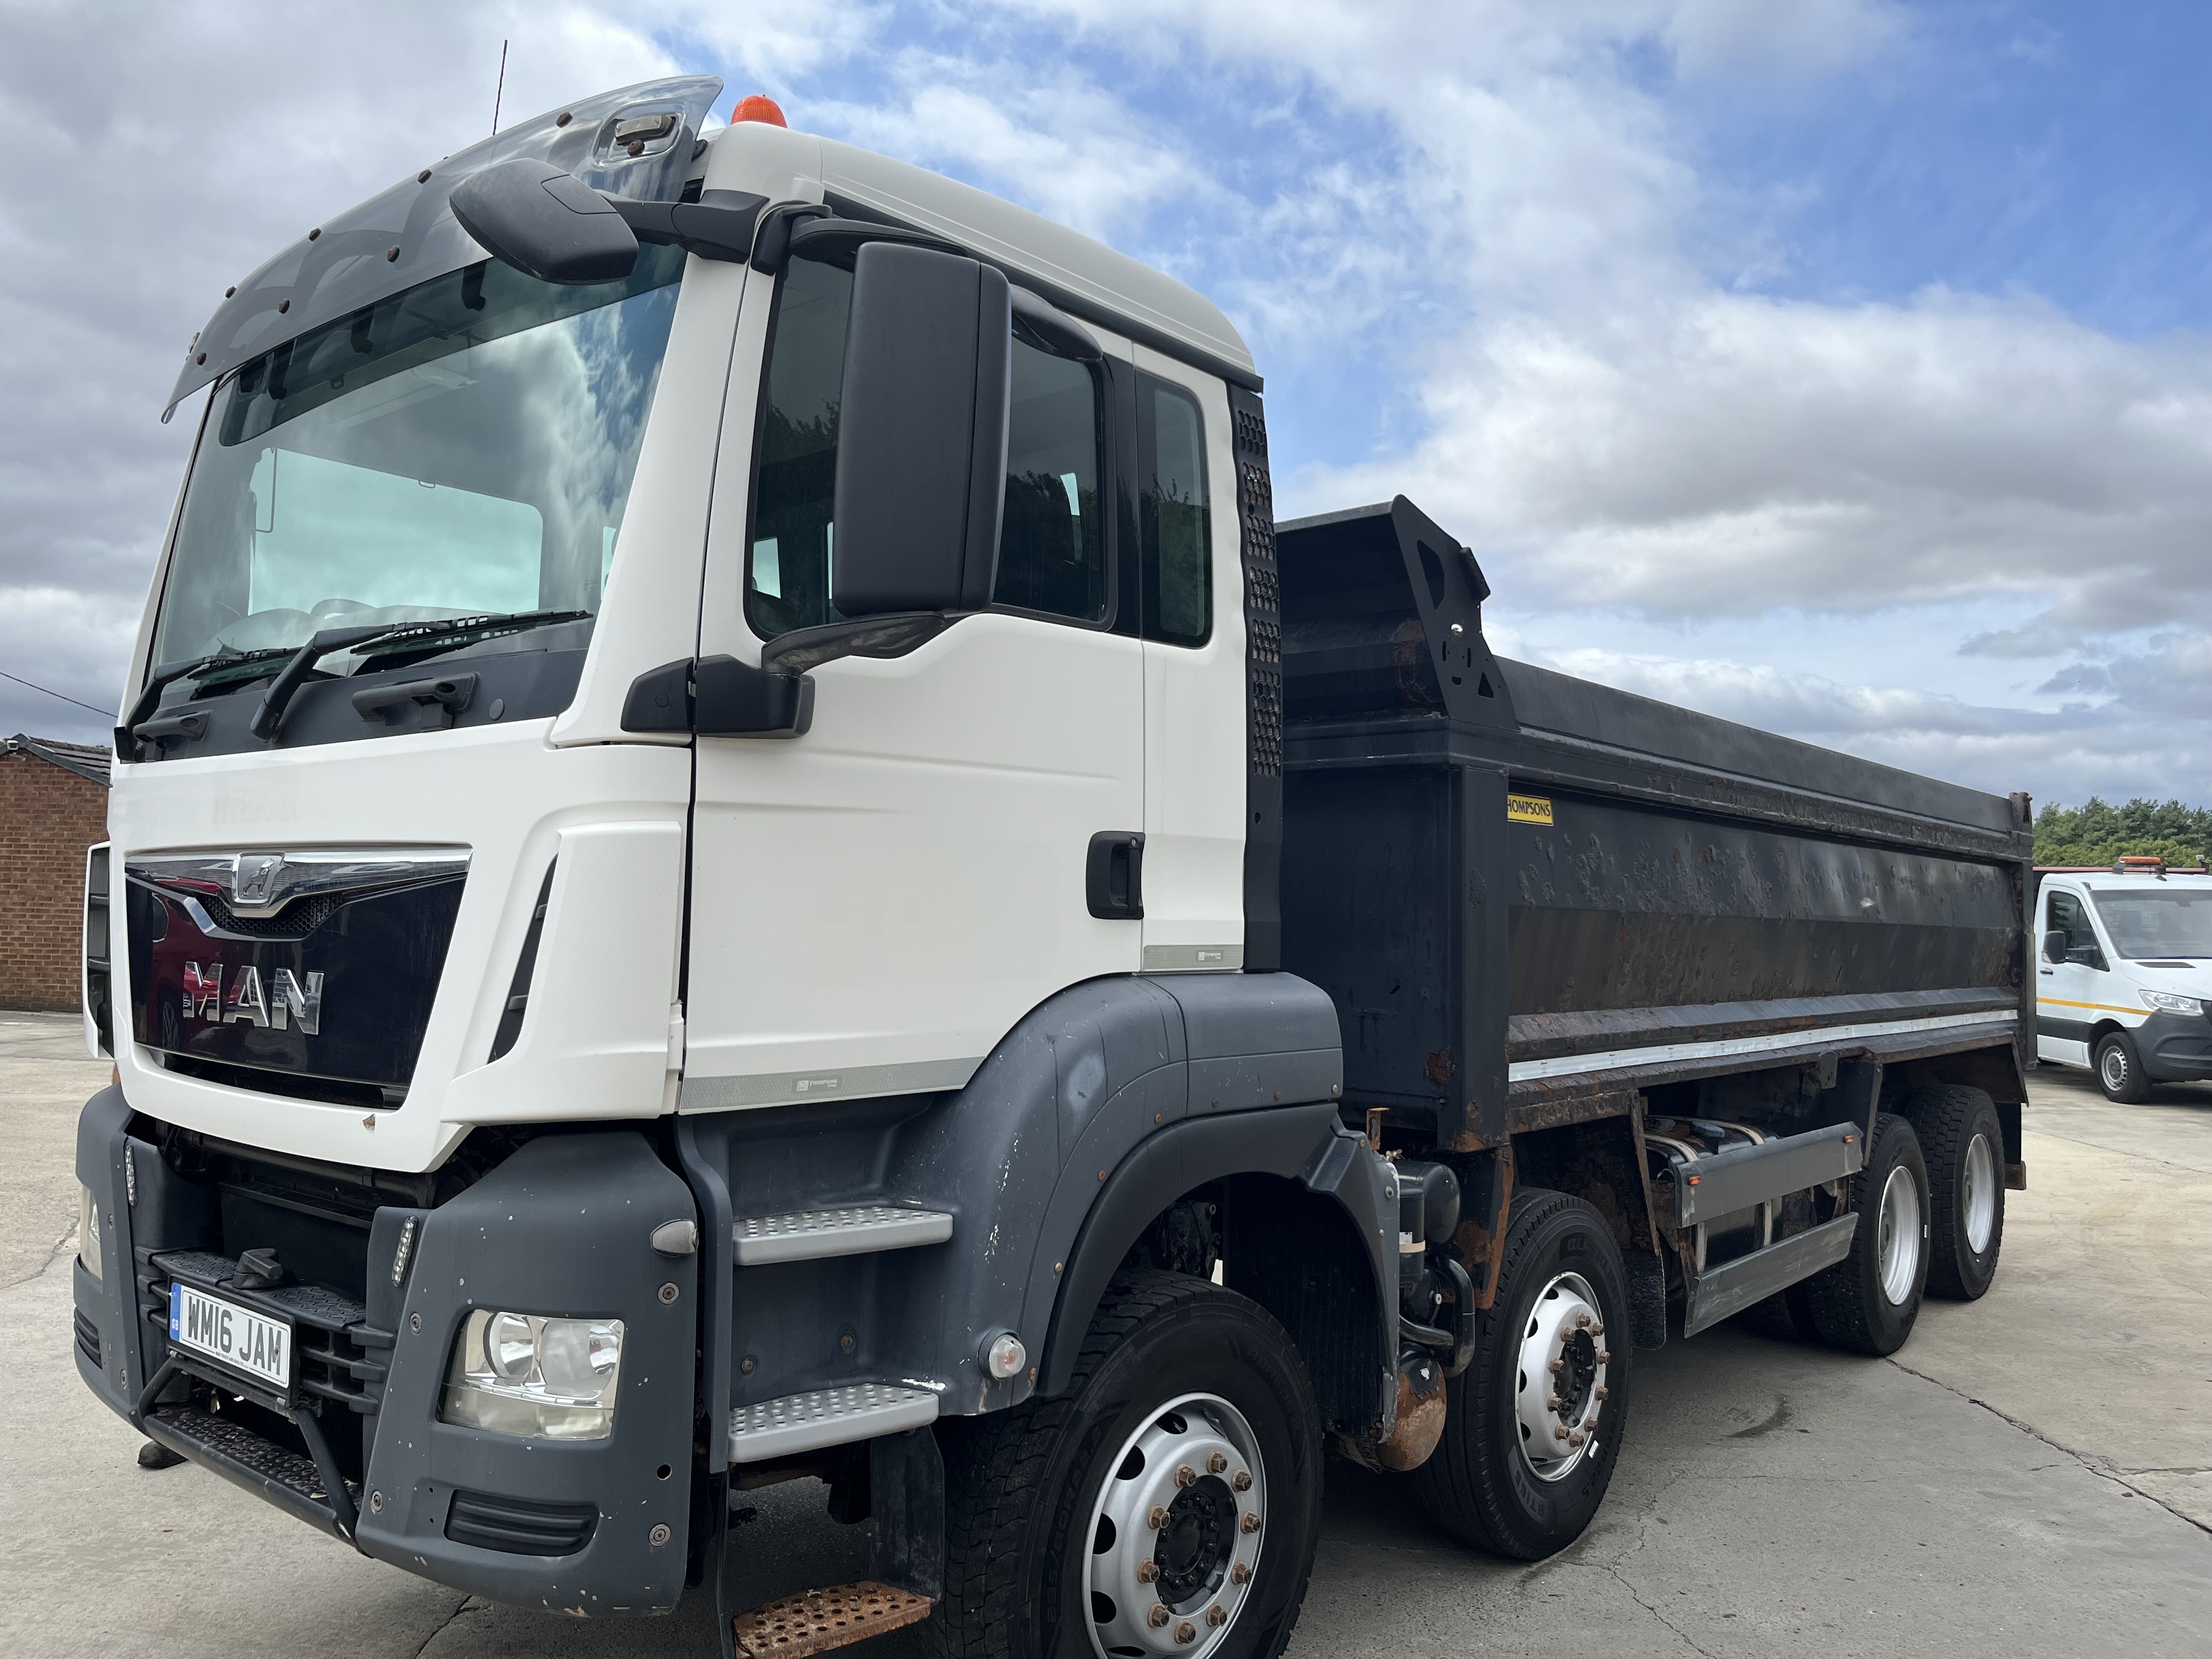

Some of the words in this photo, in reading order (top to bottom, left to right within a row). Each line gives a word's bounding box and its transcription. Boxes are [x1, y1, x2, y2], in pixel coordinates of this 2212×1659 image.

[183, 961, 325, 1036] MAN
[172, 1318, 179, 1330] GB
[188, 1296, 233, 1353] WM16
[239, 1318, 282, 1375] JAM
